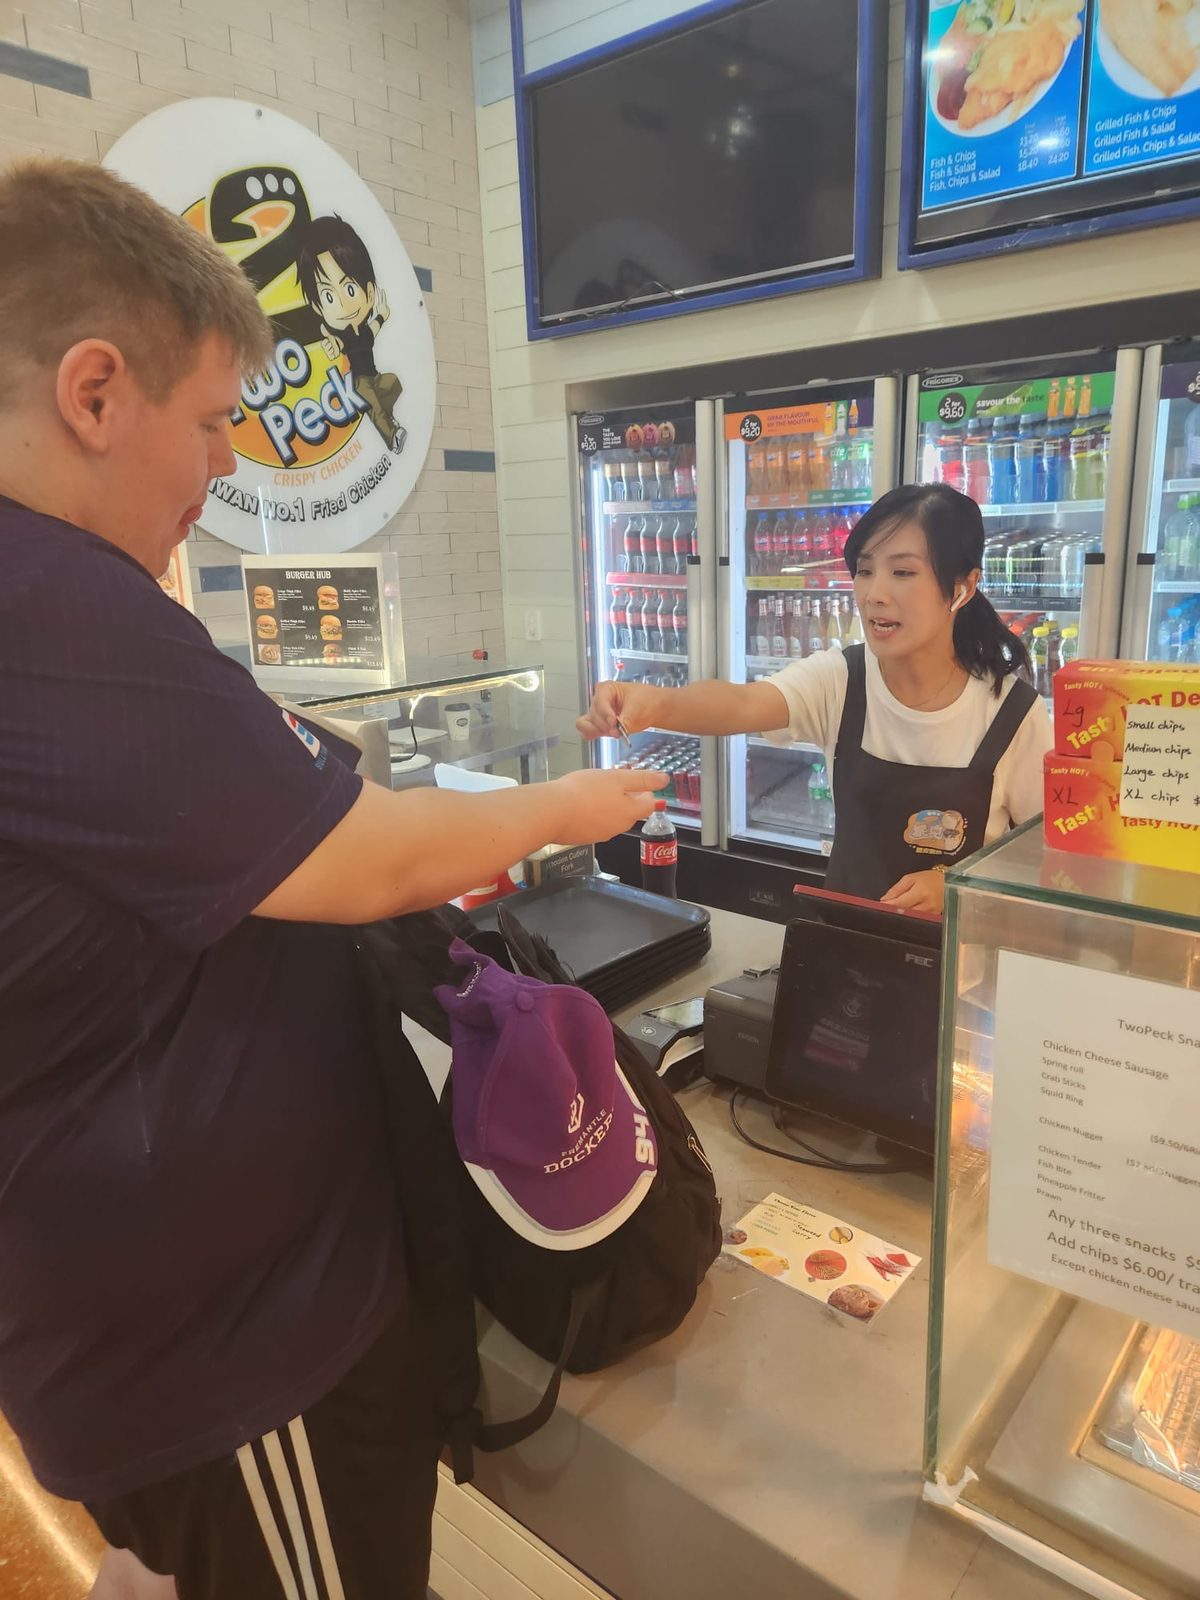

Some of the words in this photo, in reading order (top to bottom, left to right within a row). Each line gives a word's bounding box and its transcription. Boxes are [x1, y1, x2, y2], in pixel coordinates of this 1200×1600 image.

[1096, 115, 1122, 132] Grilled
[1124, 112, 1142, 125] Fish
[1144, 110, 1150, 120] &
[1152, 104, 1177, 120] Chips
[1094, 131, 1122, 148] Grilled
[1123, 128, 1140, 142] Fish
[1142, 126, 1149, 137] &
[1151, 119, 1176, 135] Salad
[930, 158, 946, 169] Fish
[948, 156, 954, 166] &
[954, 150, 976, 164] Chips
[1093, 146, 1120, 164] Grilled
[1143, 138, 1168, 153] Chips
[1168, 136, 1175, 148] &
[930, 170, 946, 180] Fish
[947, 166, 953, 176] &
[954, 160, 976, 173] Salad
[948, 175, 970, 188] Chips
[971, 174, 976, 182] &
[978, 166, 1001, 180] Salad
[944, 398, 951, 408] 2
[976, 398, 1006, 408] savour
[1006, 396, 1020, 404] the
[1022, 394, 1044, 404] taste
[259, 365, 370, 468] Peck
[940, 406, 964, 419] $9.60
[741, 426, 760, 437] $9.20
[744, 419, 750, 428] 2
[274, 471, 316, 487] CRISPY
[320, 440, 364, 481] CHICKEN
[207, 477, 260, 516] IWAN
[311, 493, 347, 521] Fried
[348, 453, 393, 505] Chicken
[286, 570, 315, 580] BURGER
[316, 570, 332, 579] HUB
[1064, 682, 1082, 690] Tasty
[1084, 680, 1098, 689] HOT
[1158, 720, 1185, 733] chips
[1124, 743, 1162, 754] Medium
[1164, 744, 1192, 760] chips
[1070, 768, 1085, 776] HOT
[1124, 766, 1156, 782] Large
[1162, 768, 1190, 784] chips
[1052, 787, 1079, 806] XL
[1124, 788, 1144, 800] XL
[1151, 790, 1180, 806] chips
[1117, 1018, 1174, 1042] TwoPeck
[1042, 1056, 1068, 1072] Spring
[1070, 1064, 1084, 1074] roll
[1043, 1040, 1082, 1057] Chicken
[1084, 1050, 1122, 1068] Cheese
[1124, 1060, 1170, 1080] Sausage
[1041, 1072, 1060, 1084] Crab
[1062, 1077, 1086, 1090] Sticks
[1040, 1086, 1063, 1100] Squid
[1065, 1093, 1084, 1106] Ring
[1039, 1116, 1071, 1132] Chicken
[1073, 1126, 1103, 1142] Nugget
[544, 1112, 613, 1174] DOCKER
[1038, 1144, 1070, 1160] Chicken
[1072, 1154, 1102, 1170] Tender
[1038, 1158, 1054, 1170] Fish
[1056, 1164, 1072, 1176] Bite
[1036, 1188, 1062, 1202] Prawn
[1037, 1173, 1077, 1194] Pineapple
[1079, 1184, 1106, 1202] Fritter
[1048, 1208, 1076, 1228] Any
[1080, 1220, 1121, 1242] three
[1124, 1236, 1177, 1262] snacks
[1047, 1231, 1076, 1250] Add
[1080, 1243, 1118, 1265] chips
[1123, 1257, 1174, 1286] $6.00/
[1051, 1253, 1086, 1273] Except
[1088, 1268, 1130, 1289] chicken
[1133, 1282, 1173, 1304] cheese
